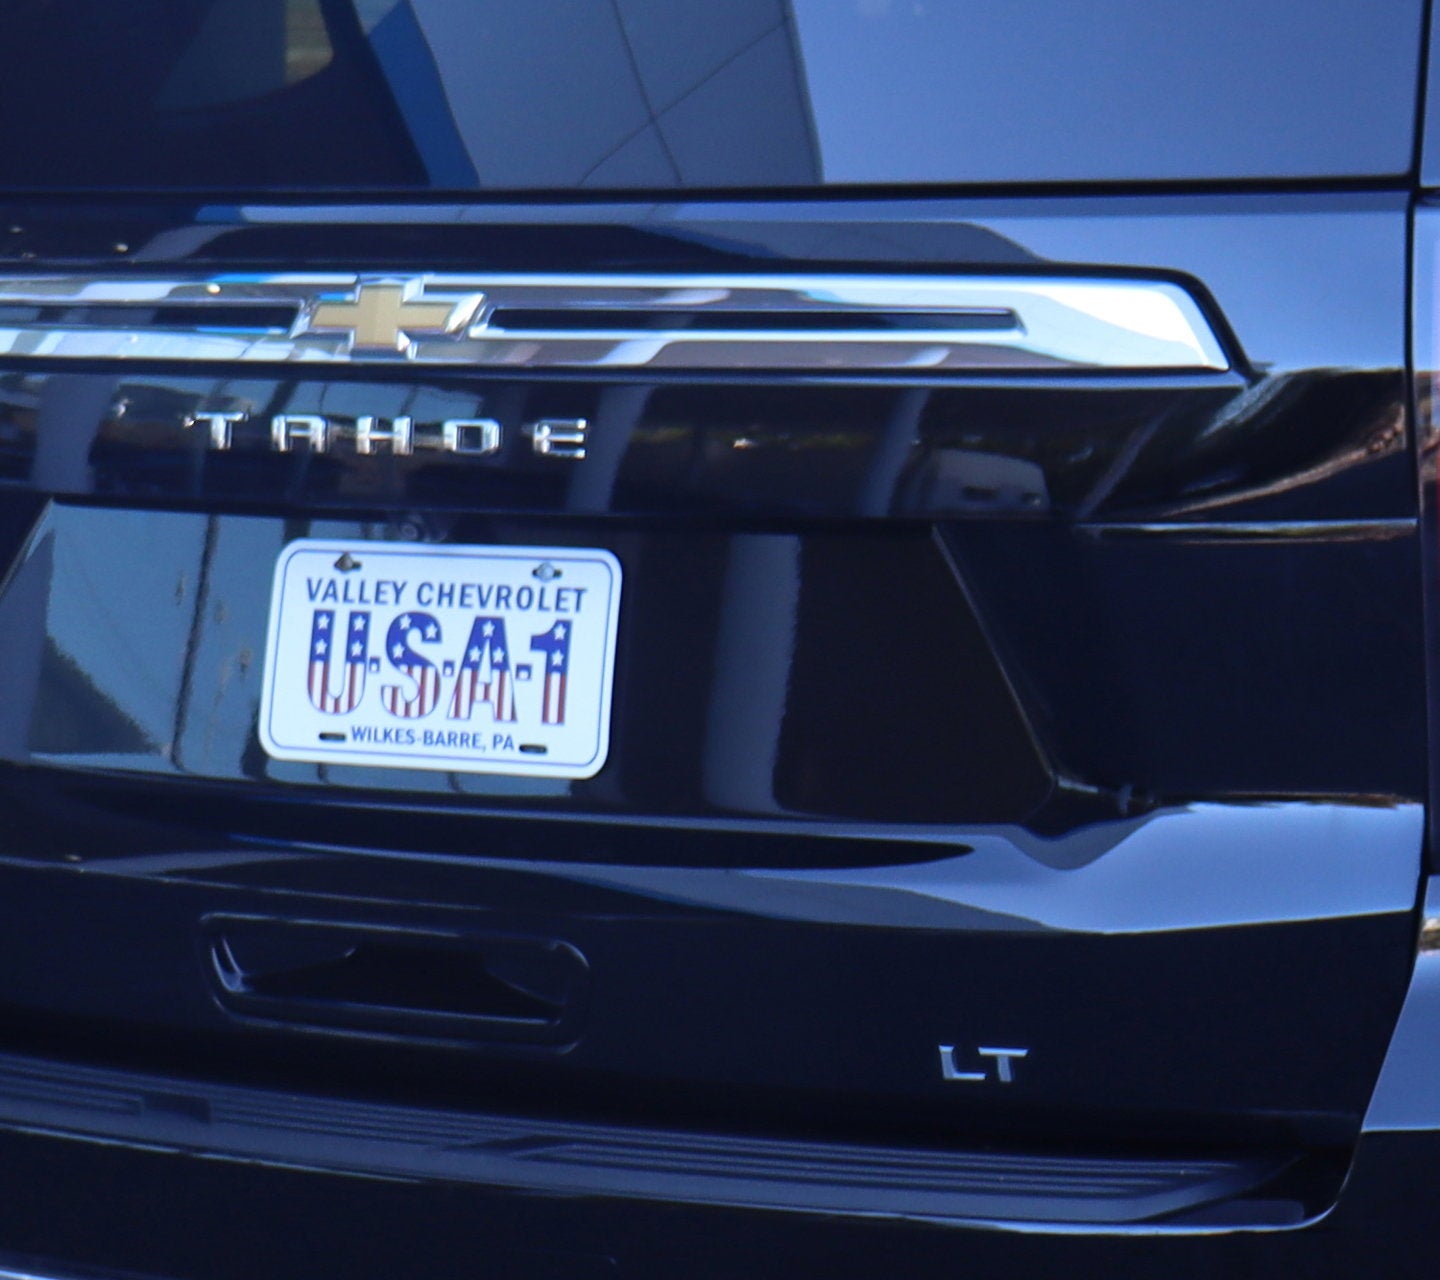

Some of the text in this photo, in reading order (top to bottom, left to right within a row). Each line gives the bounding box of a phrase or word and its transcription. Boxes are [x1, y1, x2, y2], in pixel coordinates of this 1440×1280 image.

[184, 412, 588, 458] TAHOE
[306, 578, 588, 613] VALLEY CHEVROLET
[351, 725, 515, 752] WILKES-BARRE, PA
[938, 1045, 1028, 1083] LT
